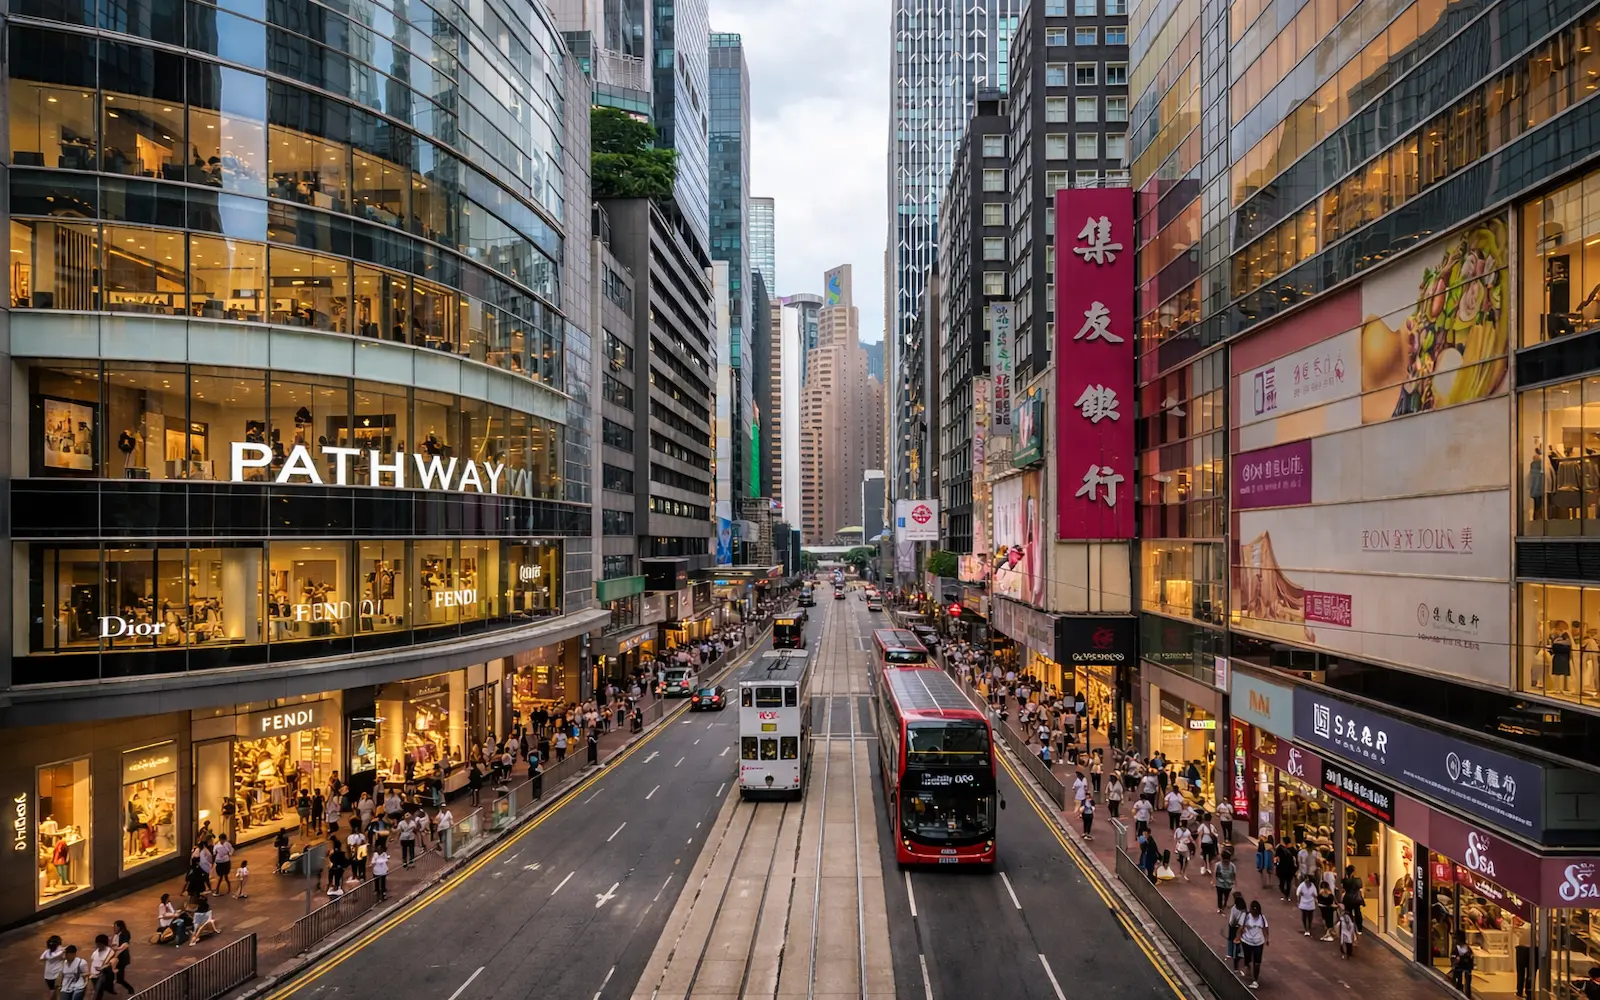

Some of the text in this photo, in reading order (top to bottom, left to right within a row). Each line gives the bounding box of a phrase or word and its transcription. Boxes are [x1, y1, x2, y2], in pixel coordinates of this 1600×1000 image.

[1073, 216, 1125, 507] 集友銀行
[230, 441, 504, 494] PATHWAY
[435, 589, 477, 608] FENDI
[98, 616, 166, 638] Dior
[262, 709, 313, 732] FENDI
